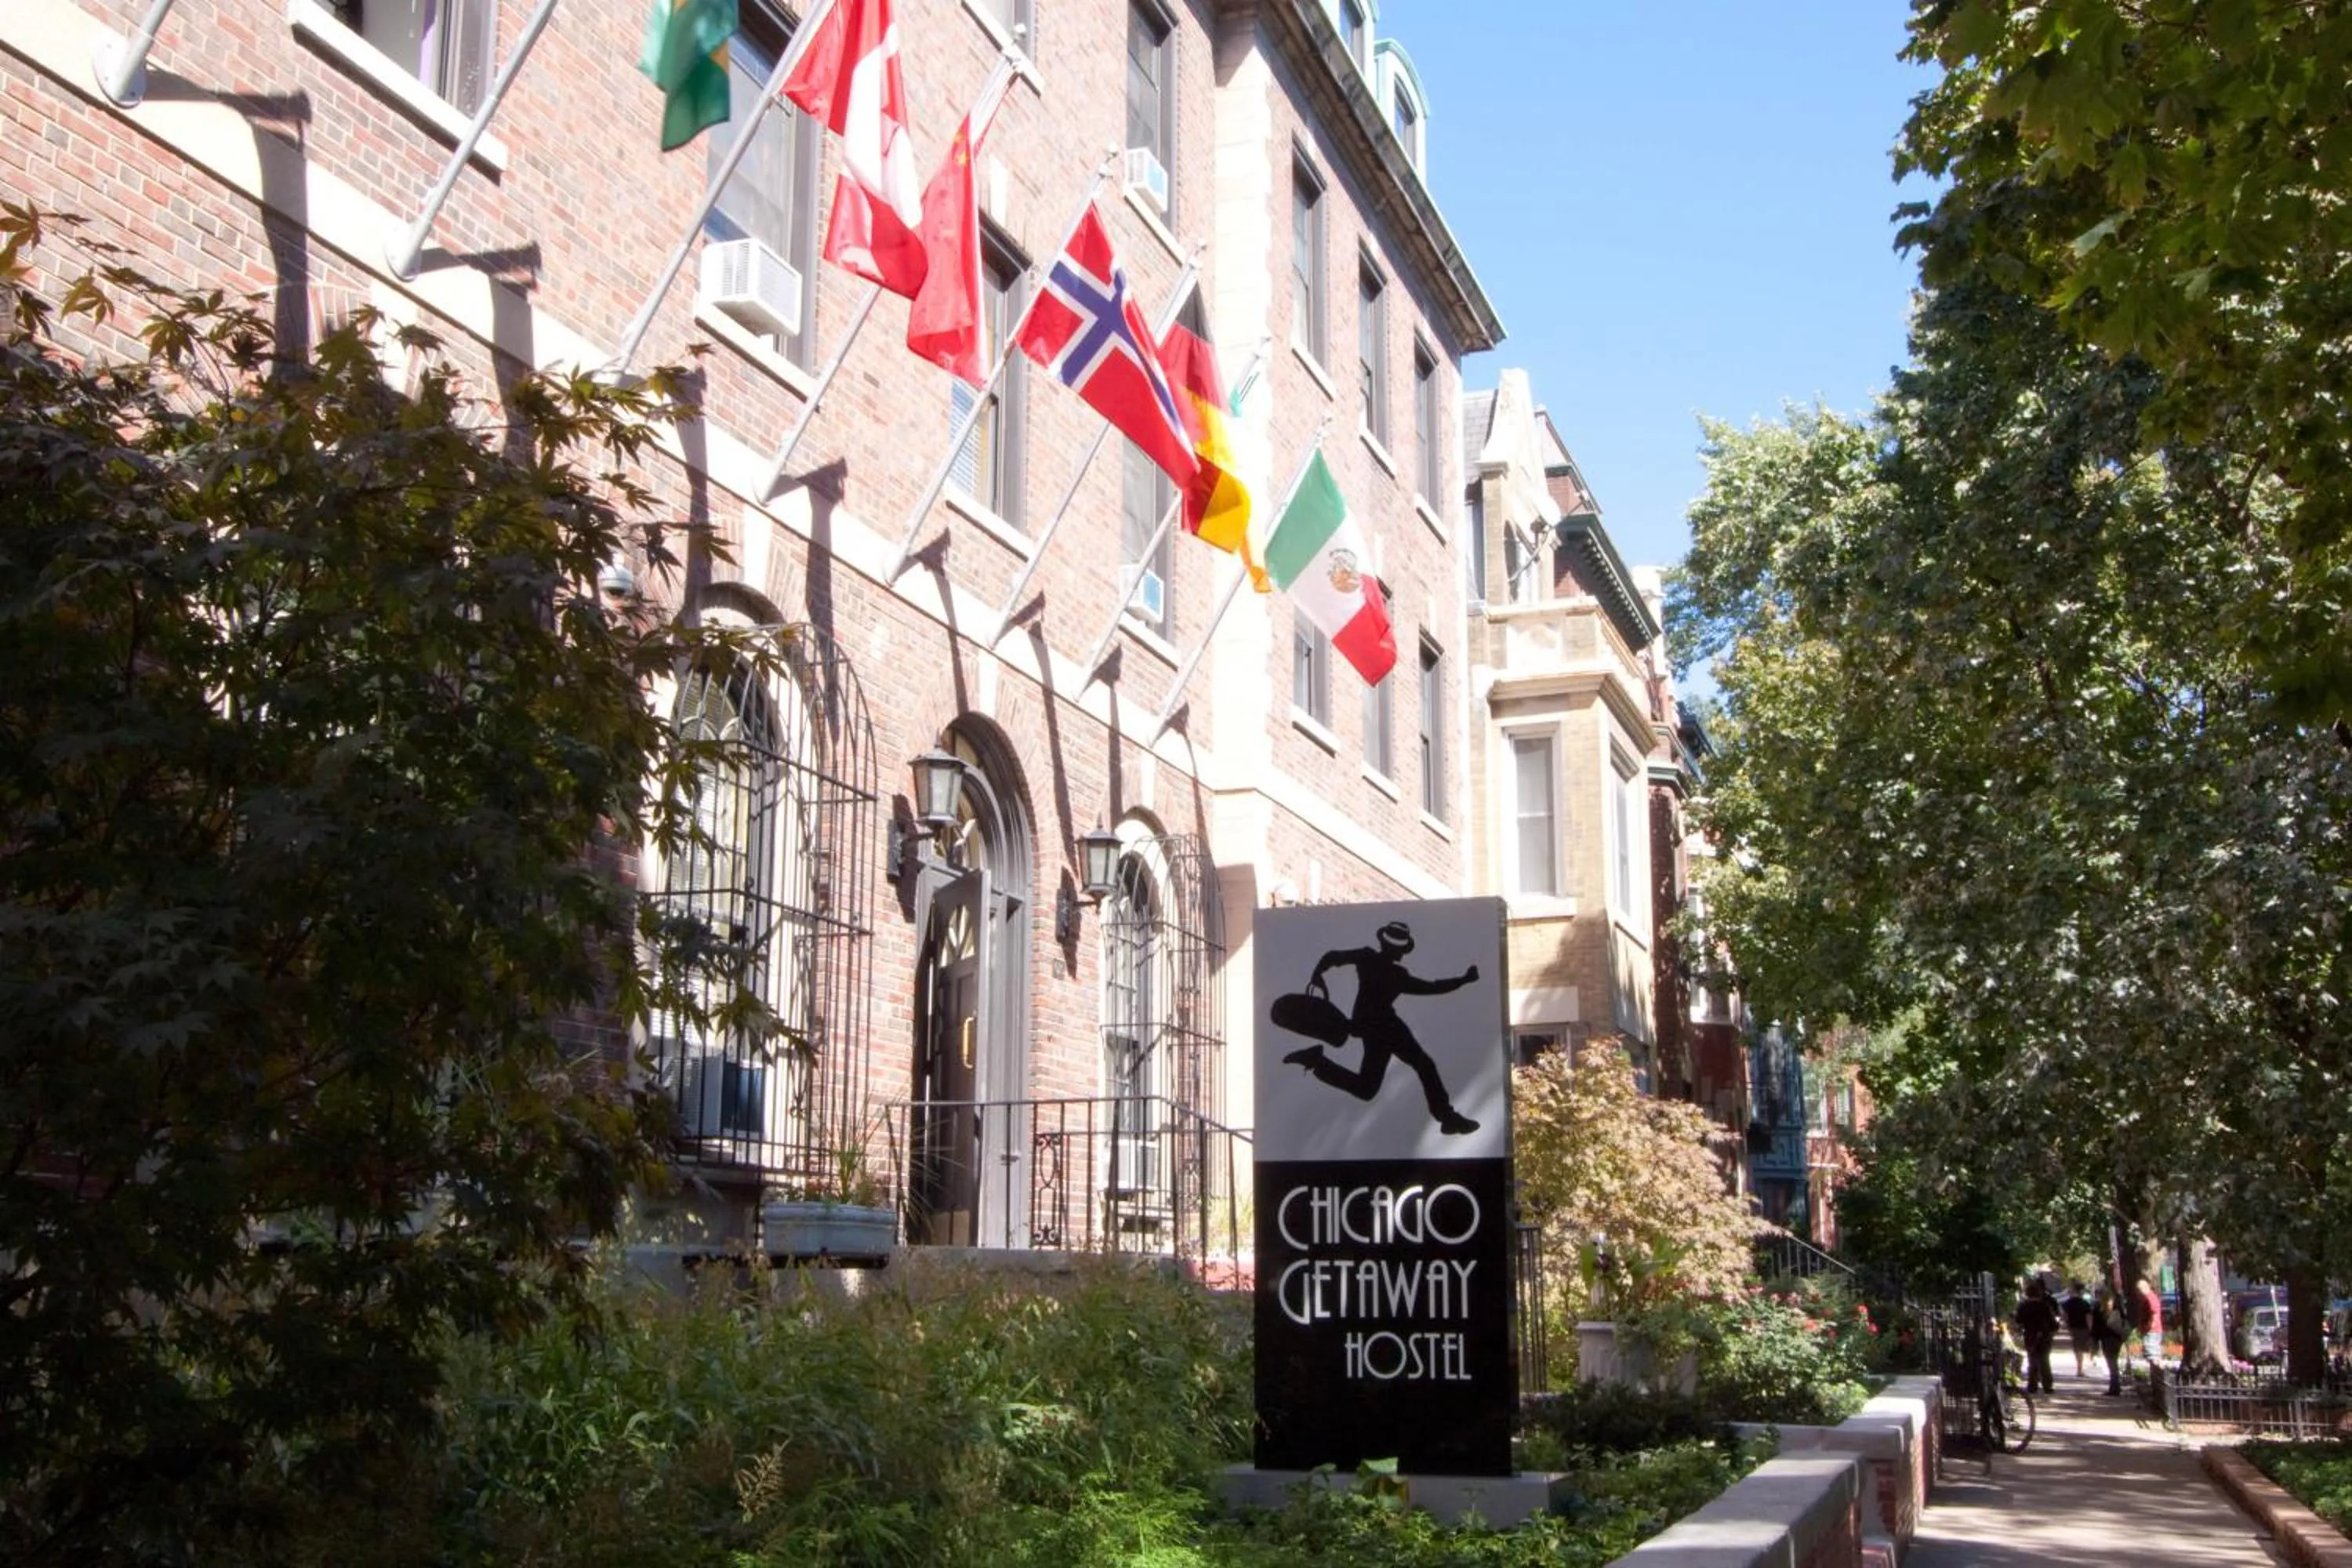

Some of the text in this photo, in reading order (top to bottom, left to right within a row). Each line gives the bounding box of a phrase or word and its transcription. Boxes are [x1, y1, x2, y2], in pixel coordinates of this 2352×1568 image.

[1278, 1183, 1480, 1250] CHICAGO
[1279, 1259, 1478, 1325] GETAWAY
[1345, 1331, 1472, 1380] HOSTEL
